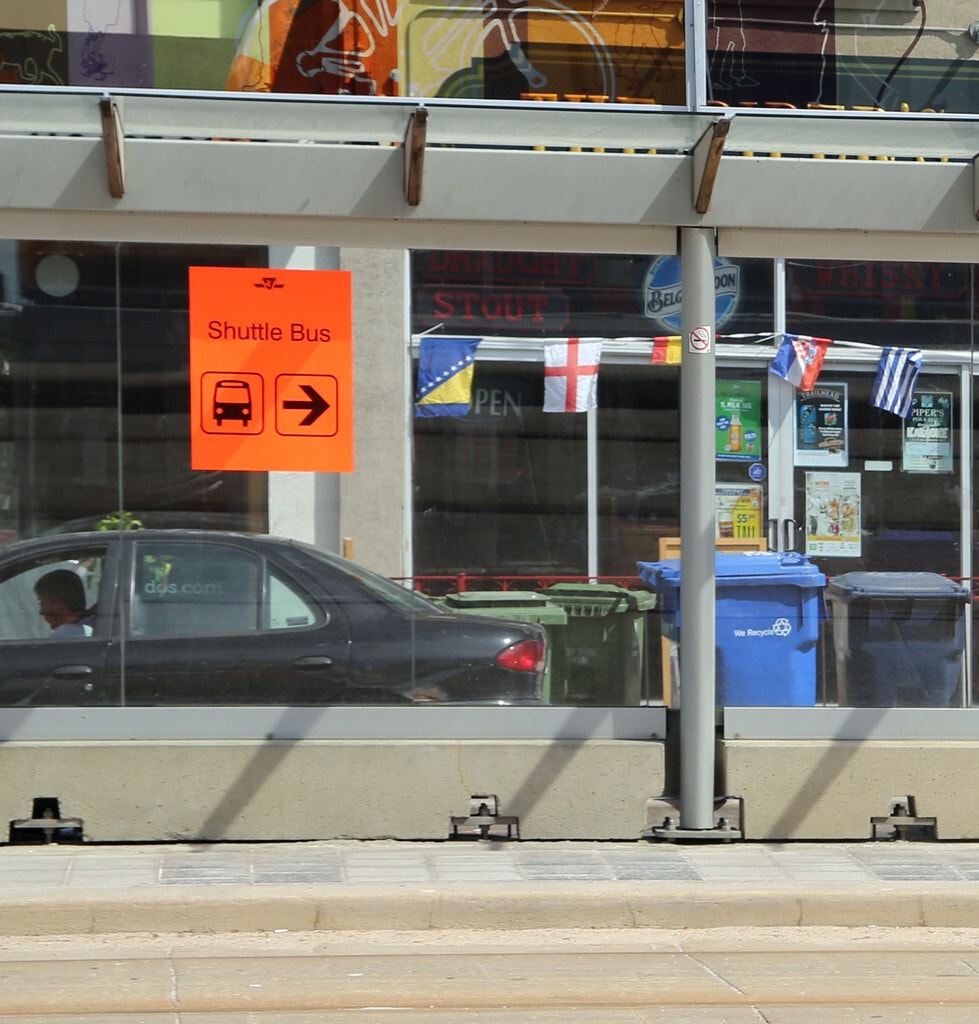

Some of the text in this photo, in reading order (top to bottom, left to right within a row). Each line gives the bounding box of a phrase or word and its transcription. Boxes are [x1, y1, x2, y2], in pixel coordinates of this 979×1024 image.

[648, 273, 736, 313] BELG OON
[433, 291, 549, 323] STOUT
[208, 320, 331, 343] Shuttle Bus
[468, 388, 523, 417] PEN
[801, 390, 840, 400] TRAILHEAD
[911, 408, 945, 417] PIPER'S
[747, 629, 775, 638] Recycle
